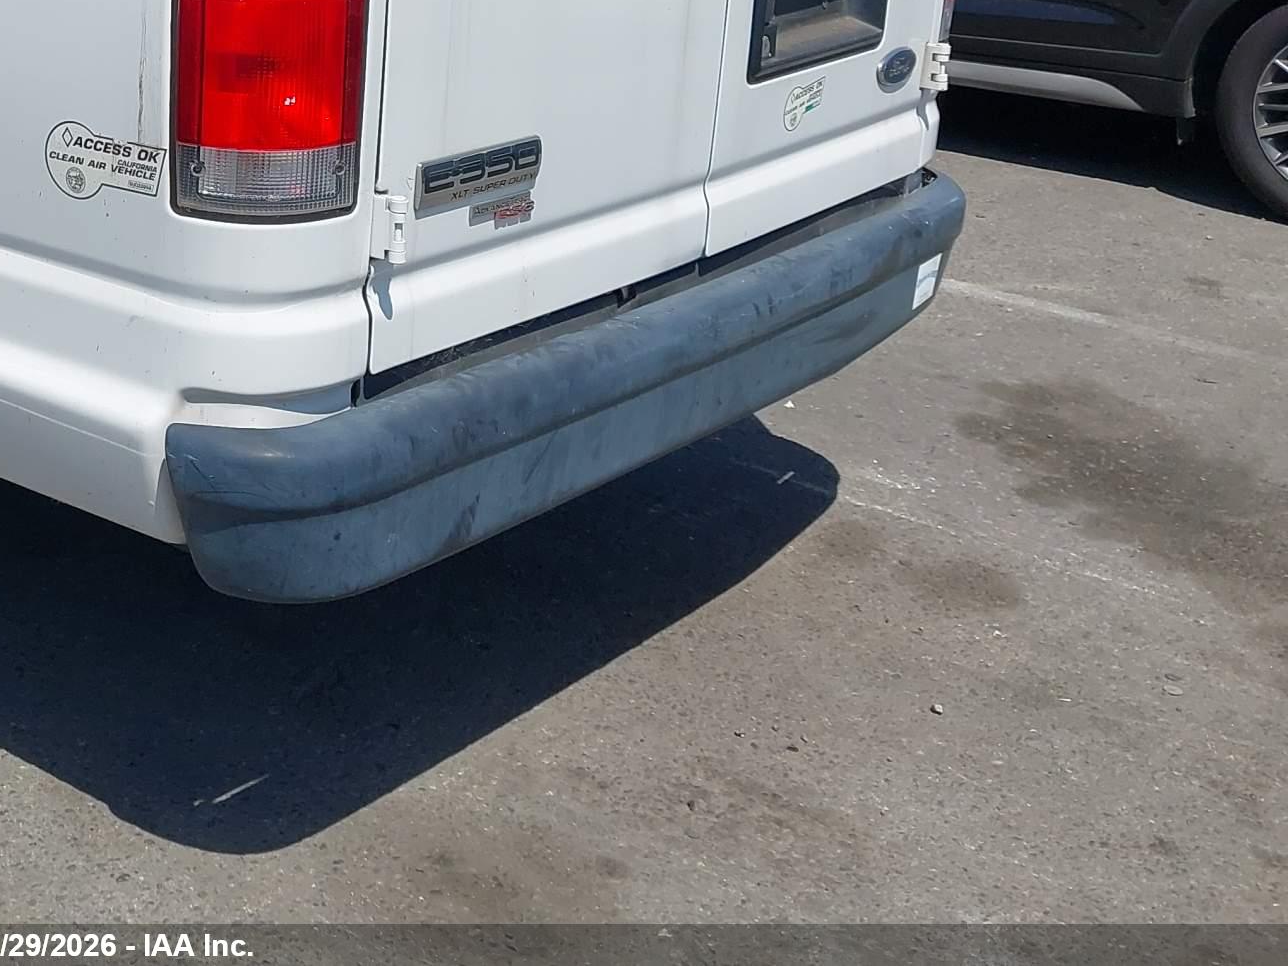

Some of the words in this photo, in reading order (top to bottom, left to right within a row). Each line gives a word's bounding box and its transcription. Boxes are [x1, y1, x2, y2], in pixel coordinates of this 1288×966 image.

[73, 136, 132, 158] ACCESS
[137, 149, 161, 164] OK
[49, 151, 84, 165] CLEAN
[87, 160, 107, 170] AIR
[111, 165, 156, 181] VEHICLE
[117, 159, 158, 173] CALIFORNIA
[450, 189, 469, 201] XLT
[472, 179, 507, 194] SUPER
